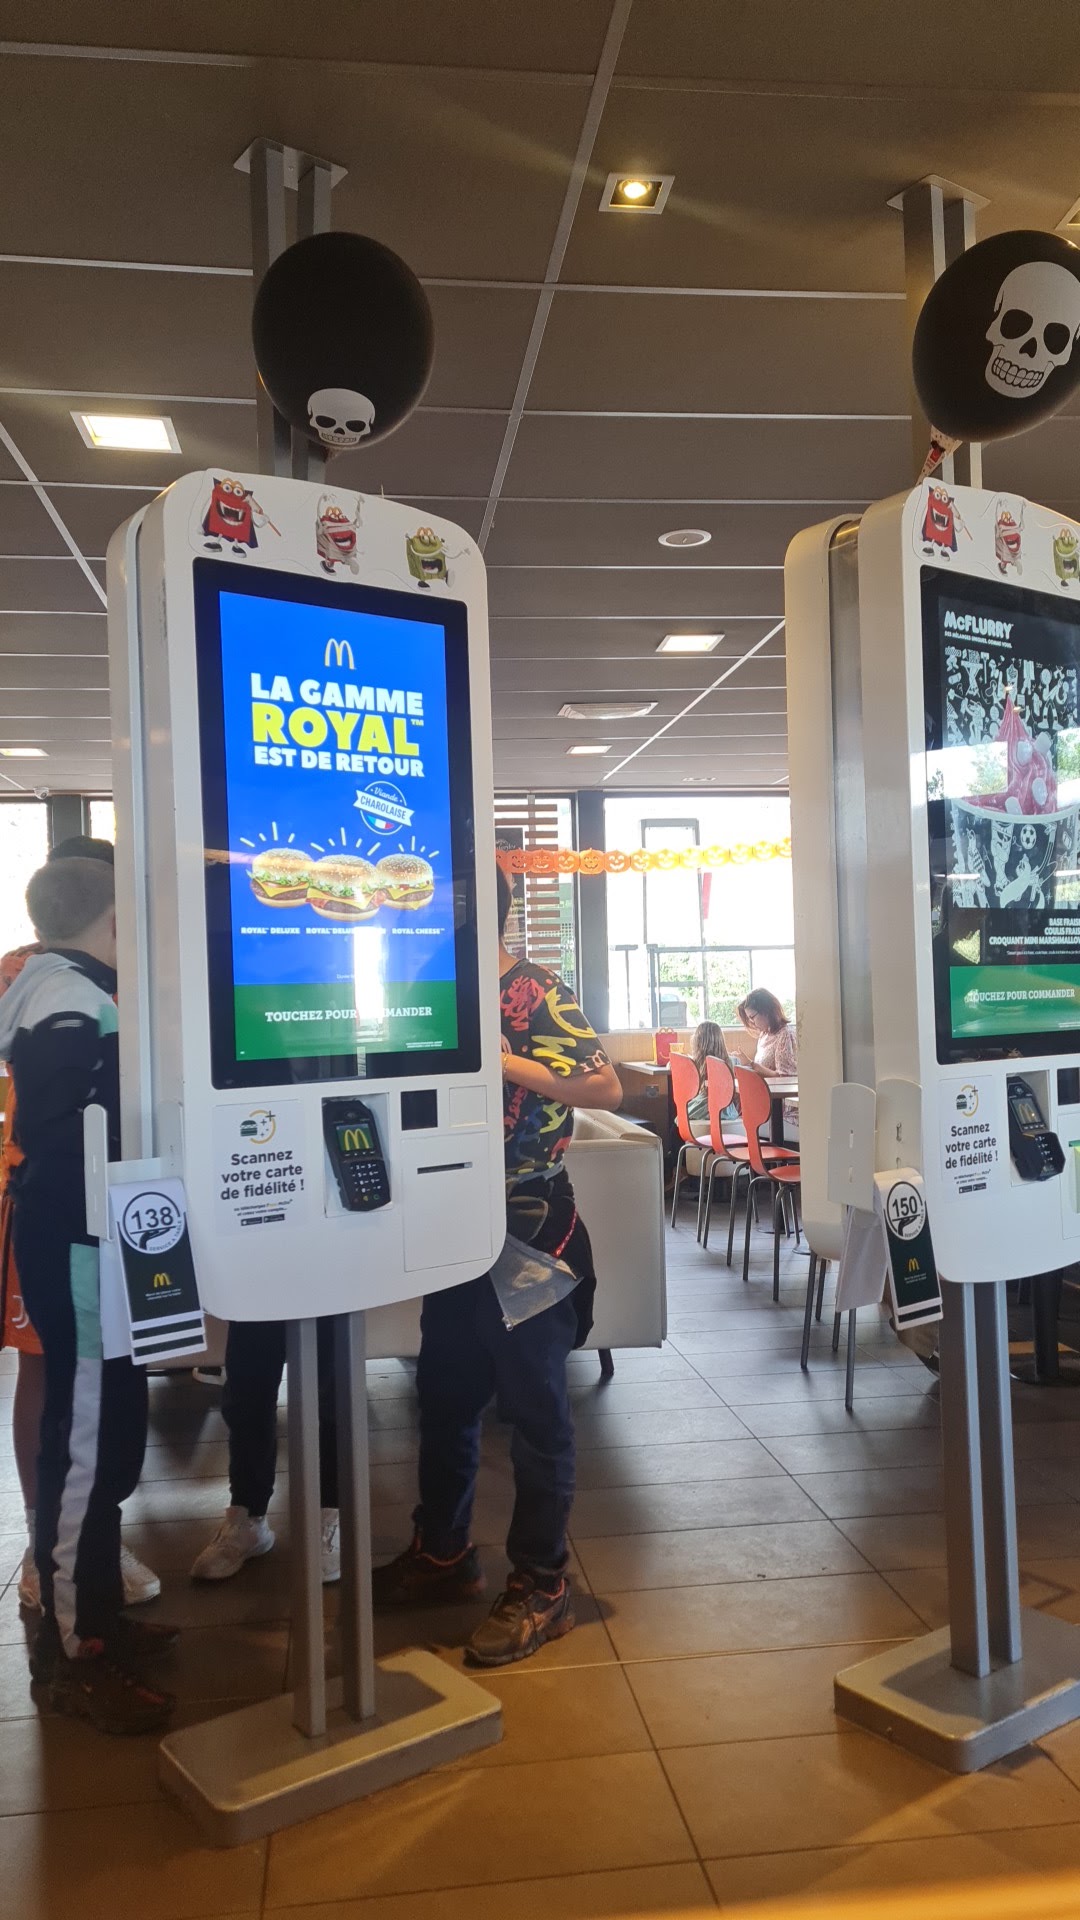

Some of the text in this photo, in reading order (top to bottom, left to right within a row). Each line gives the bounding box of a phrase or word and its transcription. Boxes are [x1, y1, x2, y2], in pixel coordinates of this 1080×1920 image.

[250, 672, 424, 716] LA GAMME
[254, 745, 425, 778] EST DE RETOUR
[373, 786, 399, 803] Viande
[360, 795, 407, 820] CHAROLAISE
[1048, 917, 1080, 926] BASE FRAIS
[1044, 926, 1065, 936] COULIS
[988, 935, 1024, 947] CROQUANT
[1024, 935, 1039, 945] MINI
[1006, 990, 1028, 1000] POUR
[1028, 988, 1076, 1000] COMMANDER
[265, 1010, 323, 1022] TOUCHEZ
[325, 1009, 357, 1020] POUR
[950, 1122, 991, 1137] Scannez
[945, 1136, 997, 1154] votre carte
[230, 1150, 293, 1166] Scannez
[945, 1156, 958, 1169] de
[959, 1150, 993, 1167] fidélité
[221, 1164, 303, 1184] votre carte
[220, 1187, 240, 1201] de
[244, 1179, 296, 1198] fidélité
[892, 1195, 918, 1218] 150
[131, 1206, 174, 1231] 138
